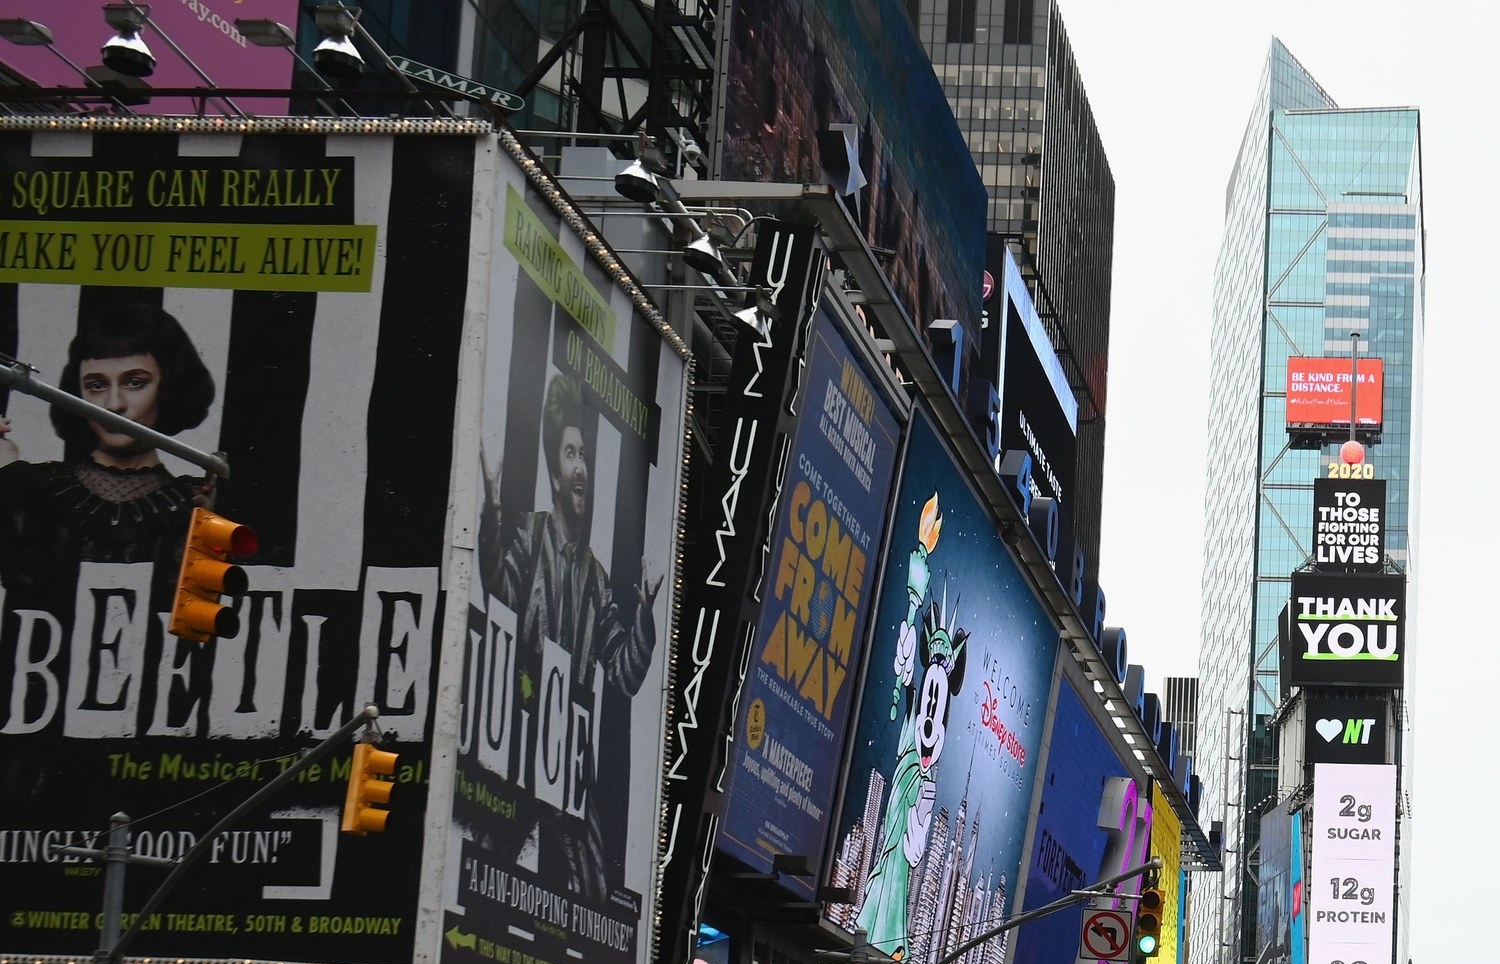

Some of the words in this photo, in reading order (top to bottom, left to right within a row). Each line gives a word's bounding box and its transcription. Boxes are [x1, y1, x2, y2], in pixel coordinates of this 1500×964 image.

[398, 59, 513, 107] LAMAR
[12, 170, 135, 215] SQUARE
[147, 169, 208, 207] CAN
[221, 168, 342, 208] REALLY
[91, 234, 155, 272] YOU
[165, 235, 246, 274] FEEL
[258, 237, 363, 277] ALIVE!
[513, 209, 563, 294] RAISING
[564, 269, 608, 346] SPIRITS
[566, 329, 585, 372] ON
[584, 346, 649, 440] BROADWAY!
[840, 356, 876, 430] WINNER!
[1291, 372, 1305, 382] BE
[1308, 373, 1334, 382] KIND
[1367, 374, 1375, 383] A
[1291, 383, 1344, 393] DISTANCE.
[819, 413, 828, 437] ALL
[823, 378, 846, 427] BEST
[843, 412, 877, 475] MUSICAL
[1019, 410, 1047, 473] ULTIMATE
[1044, 463, 1062, 504] TASTE
[1327, 463, 1374, 479] 2020
[799, 453, 821, 491] COME
[823, 482, 861, 538] TOGETHER
[860, 533, 871, 550] AT
[1318, 507, 1379, 523] THOSE
[1334, 492, 1361, 507] TO
[789, 480, 869, 610] COME
[1317, 534, 1346, 546] FOR
[1348, 534, 1379, 546] OUR
[1318, 522, 1379, 534] FIGHTING
[1317, 546, 1379, 564] LIVES
[1298, 597, 1397, 619] THANK
[1298, 623, 1397, 658] YOU
[0, 585, 424, 741] BEETLE
[760, 609, 848, 721] AWAY
[983, 646, 1031, 728] WELCOME
[458, 620, 591, 821] JUICE
[768, 677, 803, 717] REMARKABLE
[803, 707, 817, 728] TRUE
[817, 720, 835, 743] STORY
[1007, 730, 1027, 768] store
[1342, 718, 1376, 745] NT
[107, 753, 152, 782] The
[159, 753, 264, 782] Musical.
[768, 737, 814, 793] MASTERPIECE!
[977, 731, 997, 761] TIMES
[999, 755, 1024, 792] SQUARE
[1338, 794, 1372, 823] 2g
[1327, 827, 1381, 841] SUGAR
[480, 864, 569, 929] JAW-DROPPING
[1330, 877, 1375, 905] 12g
[28, 911, 89, 930] WINTER
[167, 912, 238, 934] THEATRE,
[245, 915, 287, 933] 50TH
[291, 915, 303, 933] &
[309, 916, 402, 936] BROADWAY
[1316, 910, 1386, 924] PROTEIN
